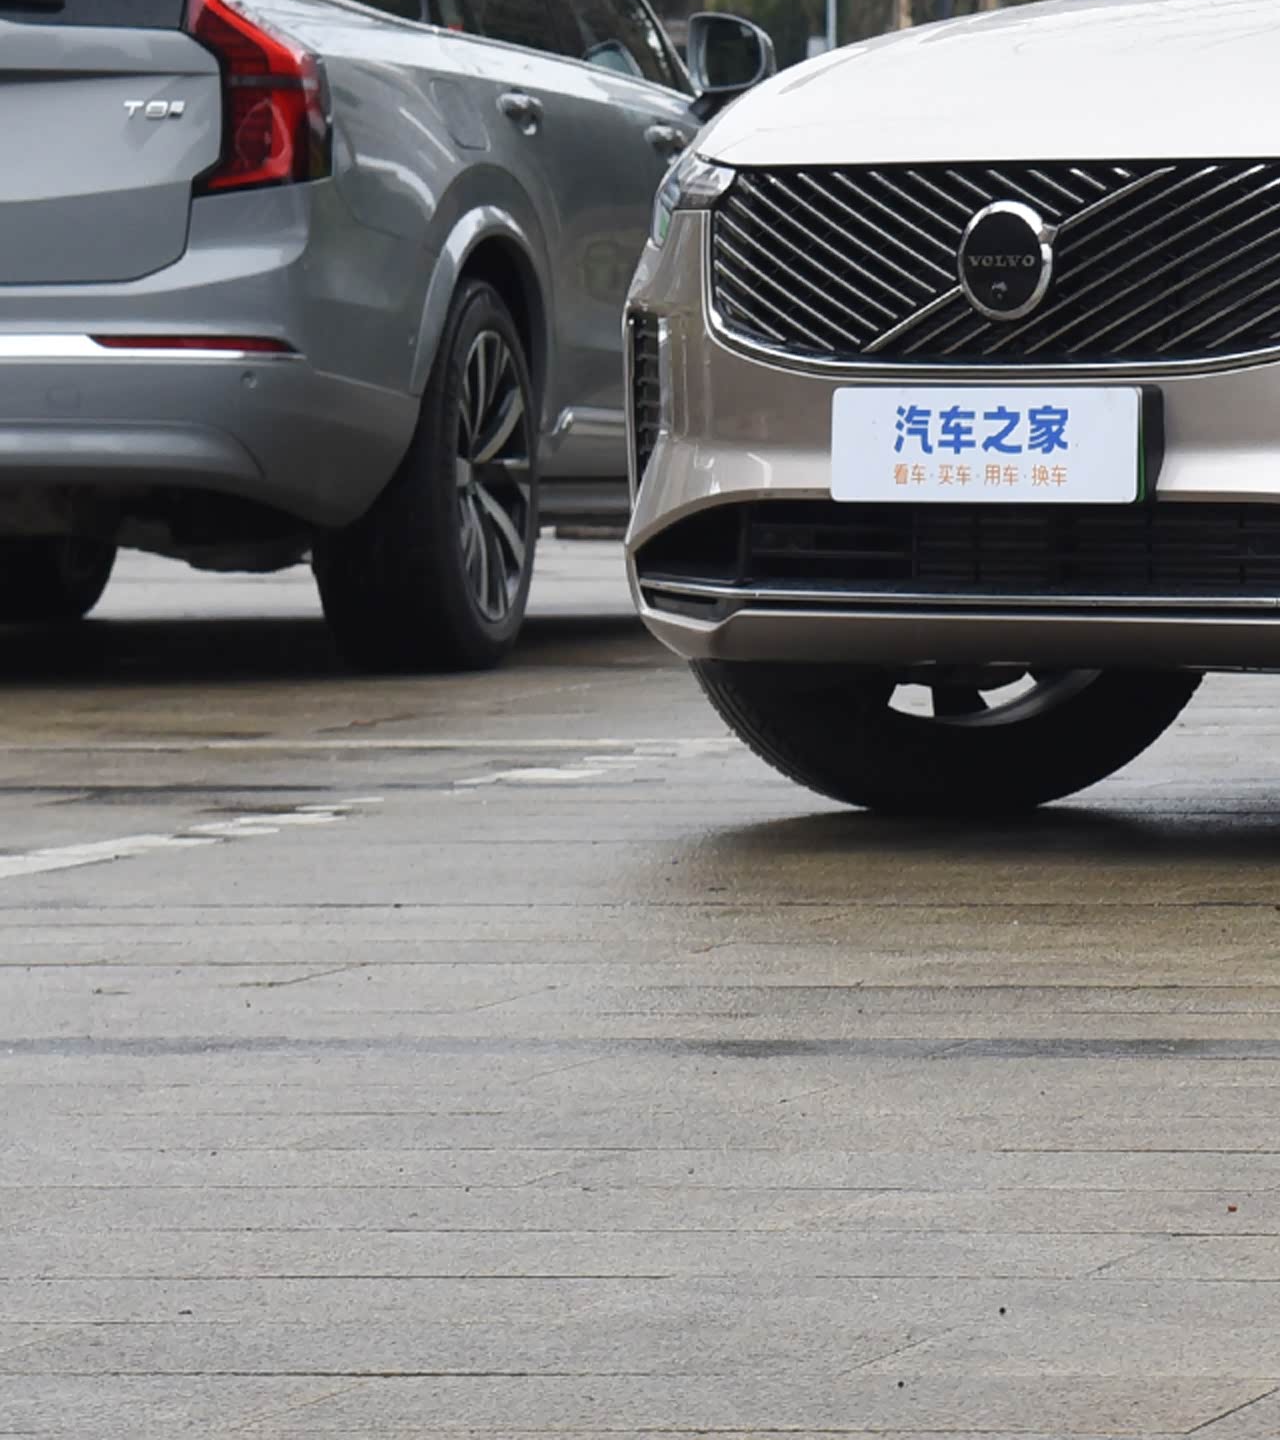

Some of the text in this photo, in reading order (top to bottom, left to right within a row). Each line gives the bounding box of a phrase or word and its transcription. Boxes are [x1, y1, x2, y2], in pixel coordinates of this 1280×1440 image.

[967, 255, 1036, 267] VOLVO
[894, 405, 1069, 454] 汽车之家
